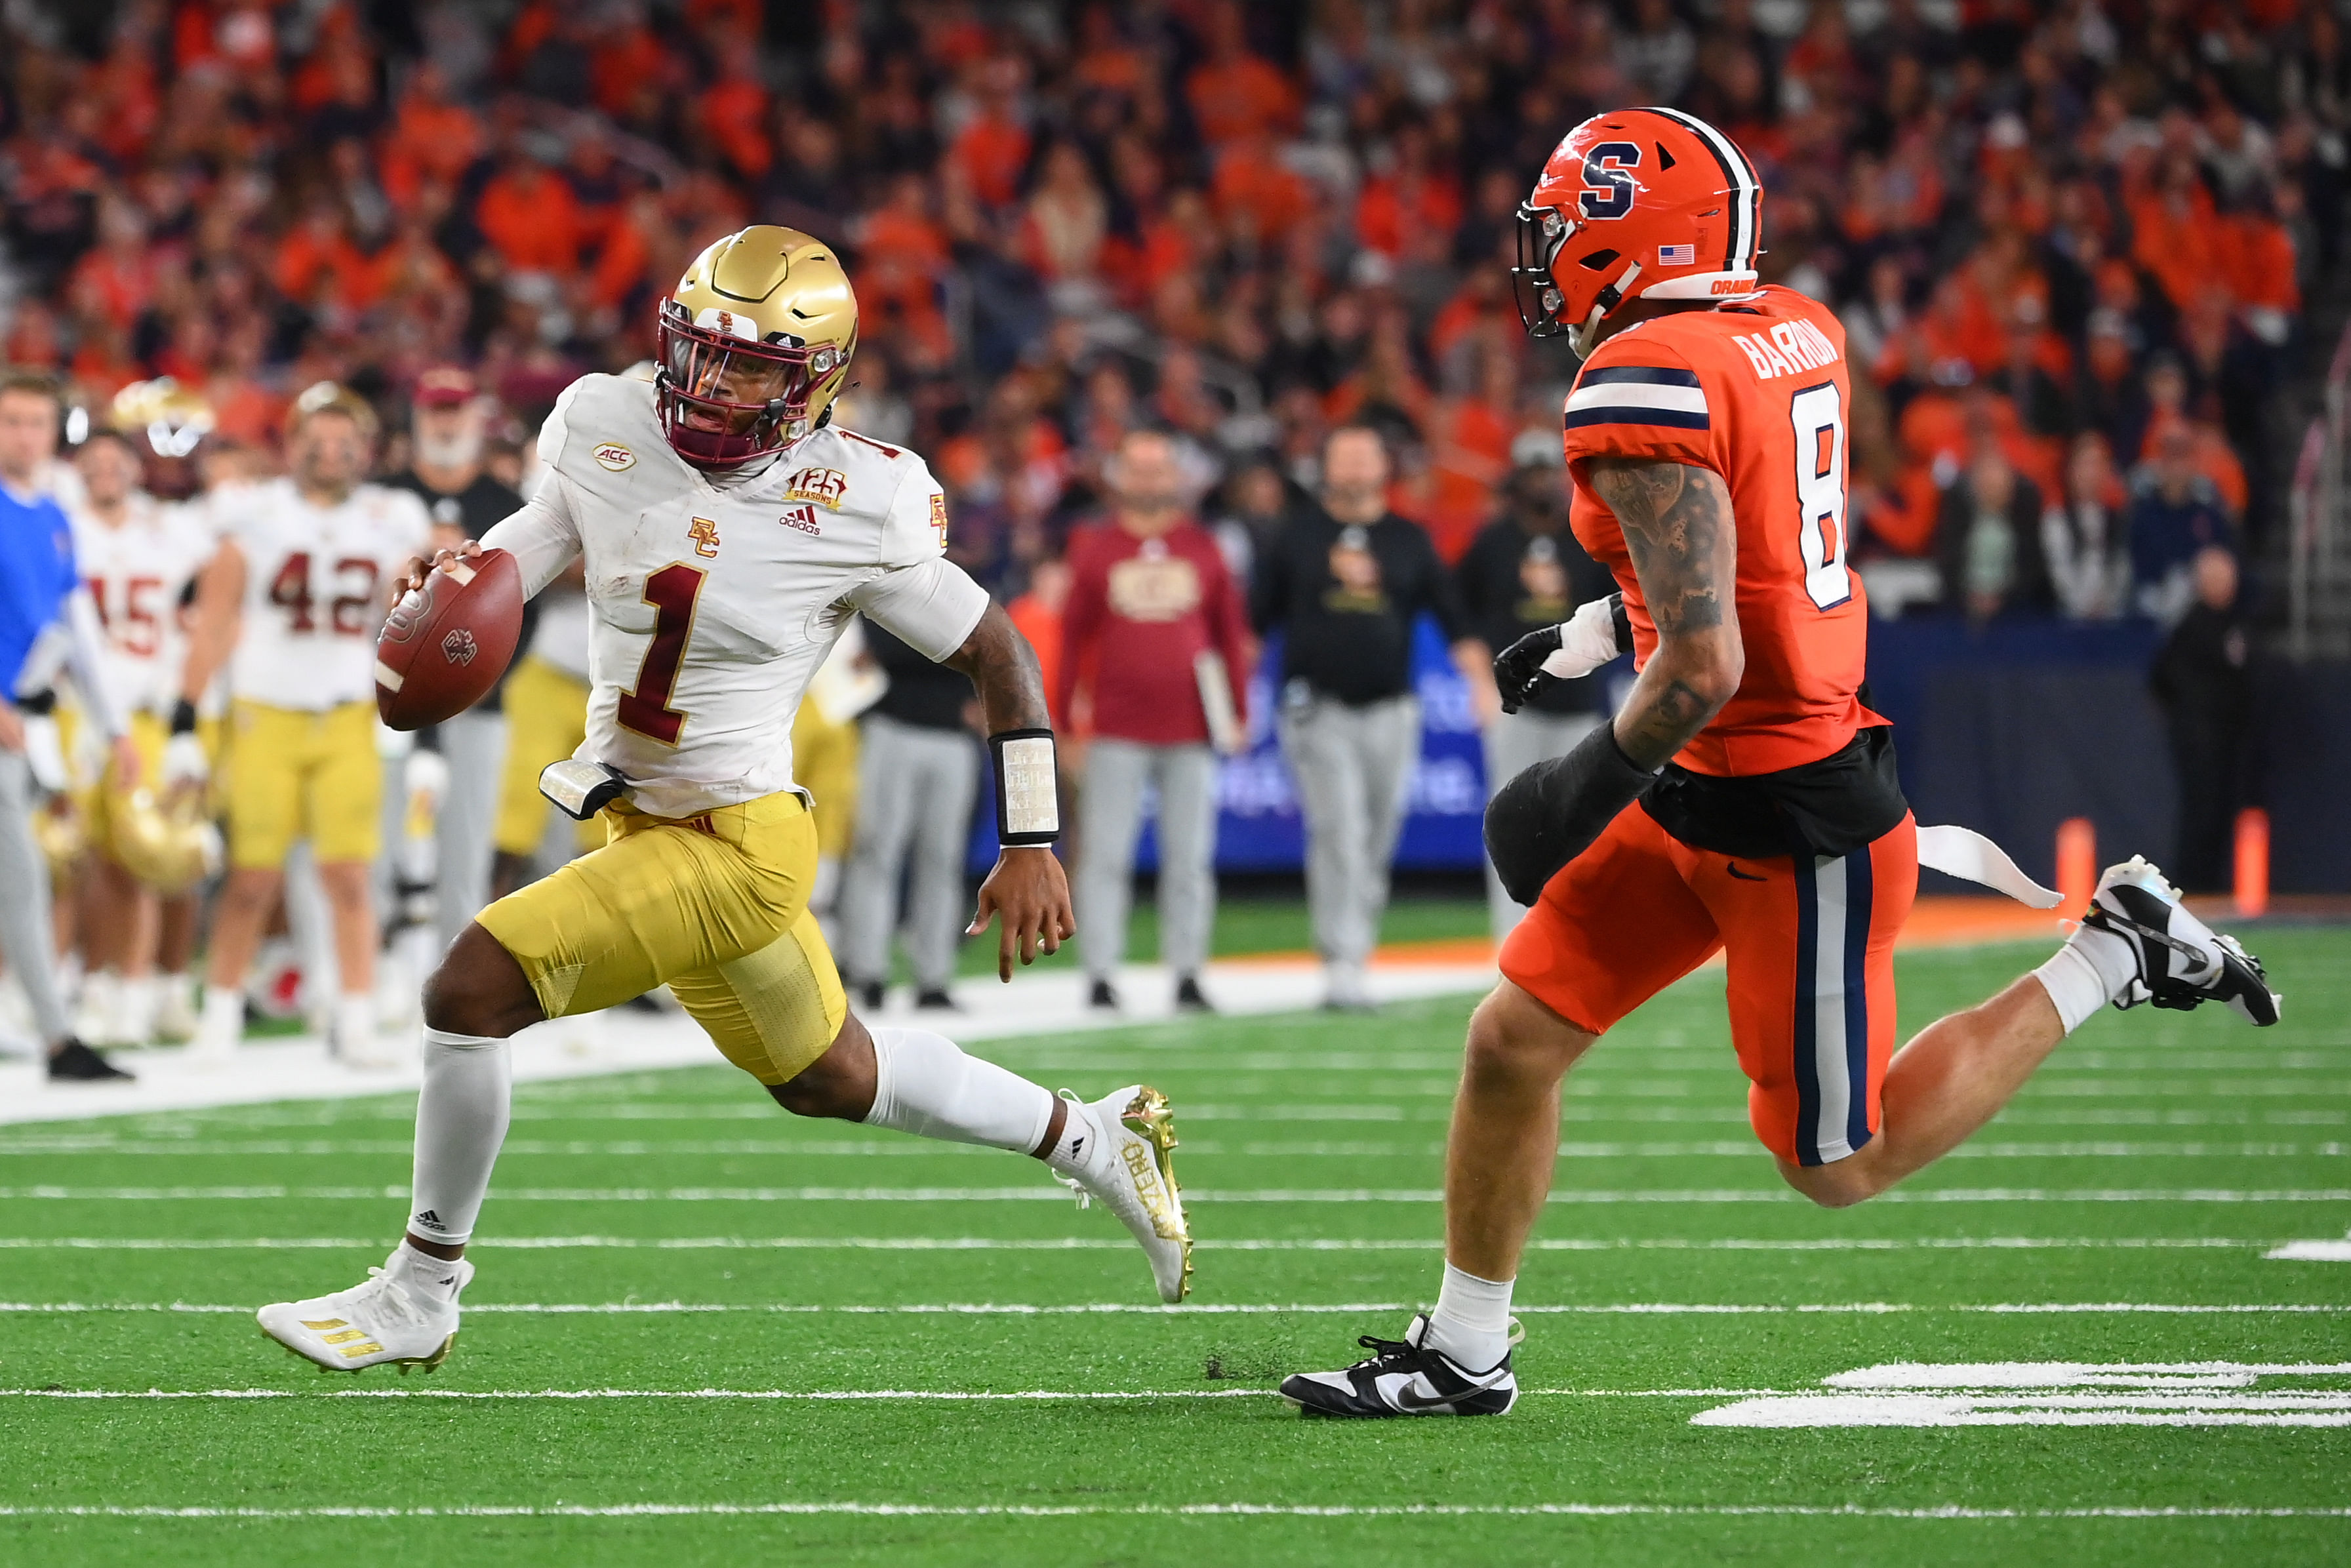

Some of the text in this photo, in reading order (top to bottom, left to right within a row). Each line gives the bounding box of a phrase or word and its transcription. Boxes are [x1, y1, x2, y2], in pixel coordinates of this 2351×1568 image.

[1577, 141, 1643, 220] S
[1731, 317, 1839, 380] BARRON
[597, 449, 630, 462] ACC
[790, 468, 846, 501] 125
[778, 514, 821, 536] adidas
[793, 490, 832, 505] SEASONS
[1789, 378, 1853, 613] 8
[268, 550, 380, 635] 42
[615, 559, 709, 750] 1
